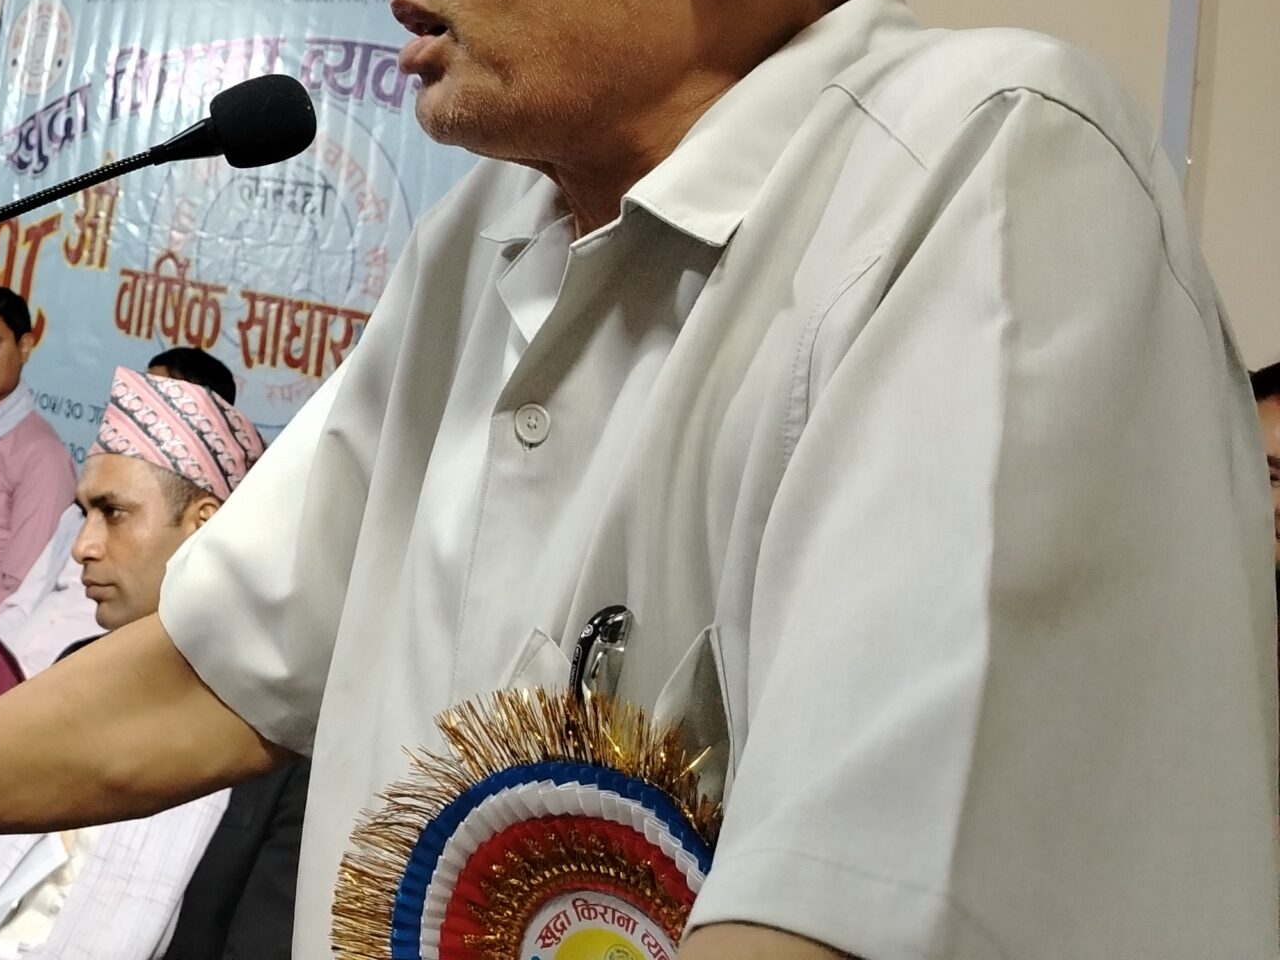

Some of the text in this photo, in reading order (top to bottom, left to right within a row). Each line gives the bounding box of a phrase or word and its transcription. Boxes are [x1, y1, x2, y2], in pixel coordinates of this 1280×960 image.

[114, 249, 373, 378] वार्षिक साधार
[534, 908, 573, 950] खुद्रा
[571, 897, 640, 937] किराना
